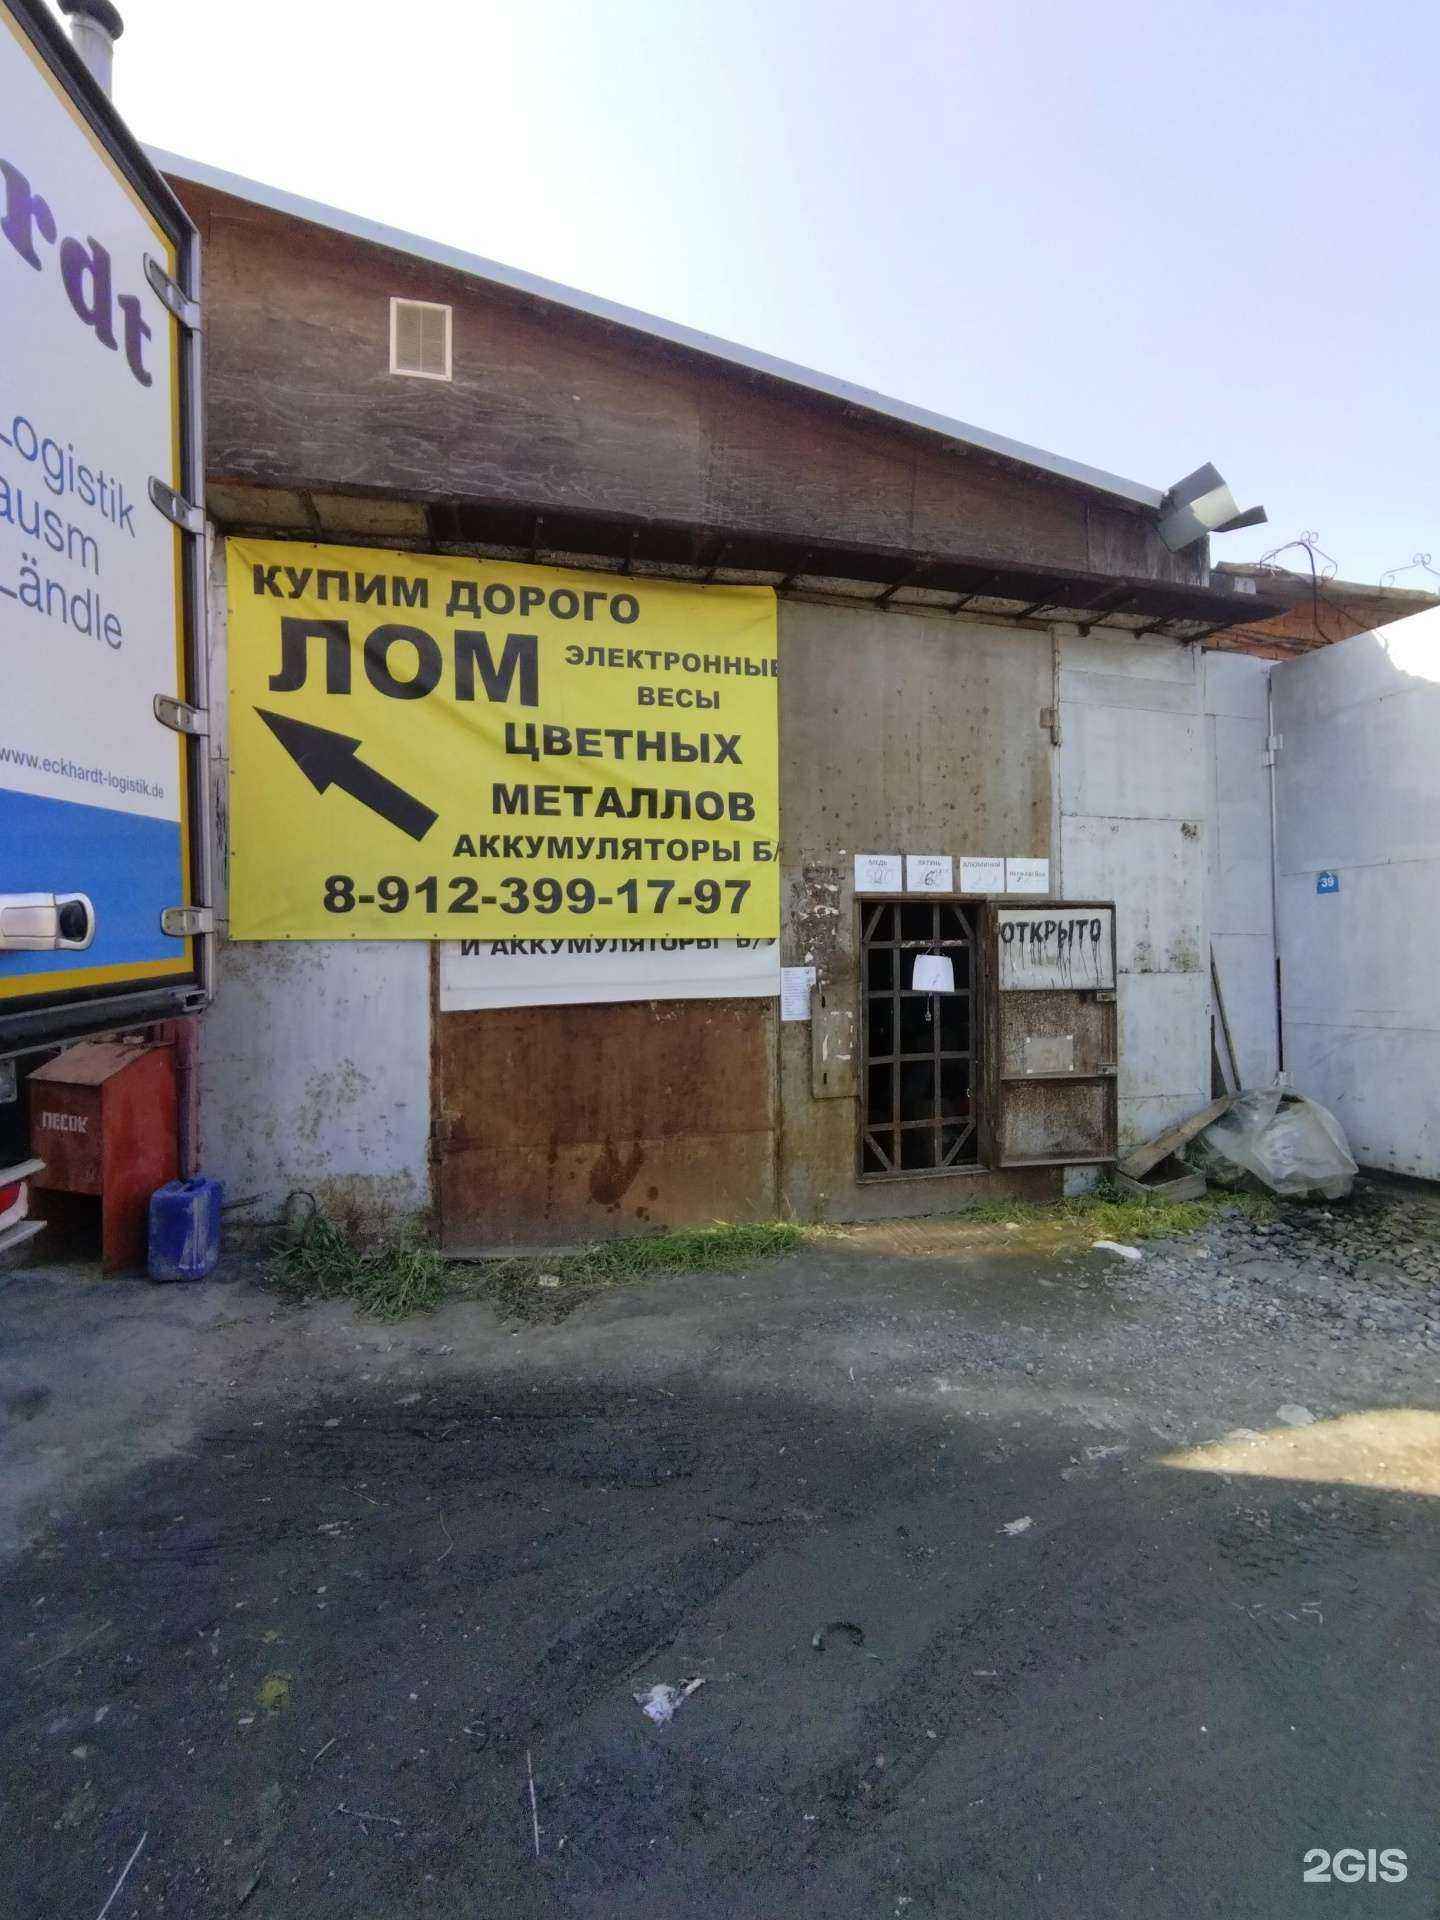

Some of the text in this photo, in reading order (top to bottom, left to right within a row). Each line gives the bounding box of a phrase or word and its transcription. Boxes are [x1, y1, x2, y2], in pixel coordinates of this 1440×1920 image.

[0, 415, 135, 538] ogistik
[252, 563, 640, 625] КУПИМ ДОРОГО
[268, 615, 539, 707] ЛОМ
[637, 685, 720, 710] ВЕСЫ
[504, 721, 743, 765] ЦВЕТНЫХ
[491, 782, 756, 822] МЕТАЛЛОВ
[452, 834, 741, 862] АККУМУЛЯТОРЫ
[323, 874, 752, 914] 8-912-399-17-97
[460, 937, 480, 957] И
[1000, 918, 1101, 949] ОТКРЫТО
[42, 1111, 89, 1133] ПЕСОК
